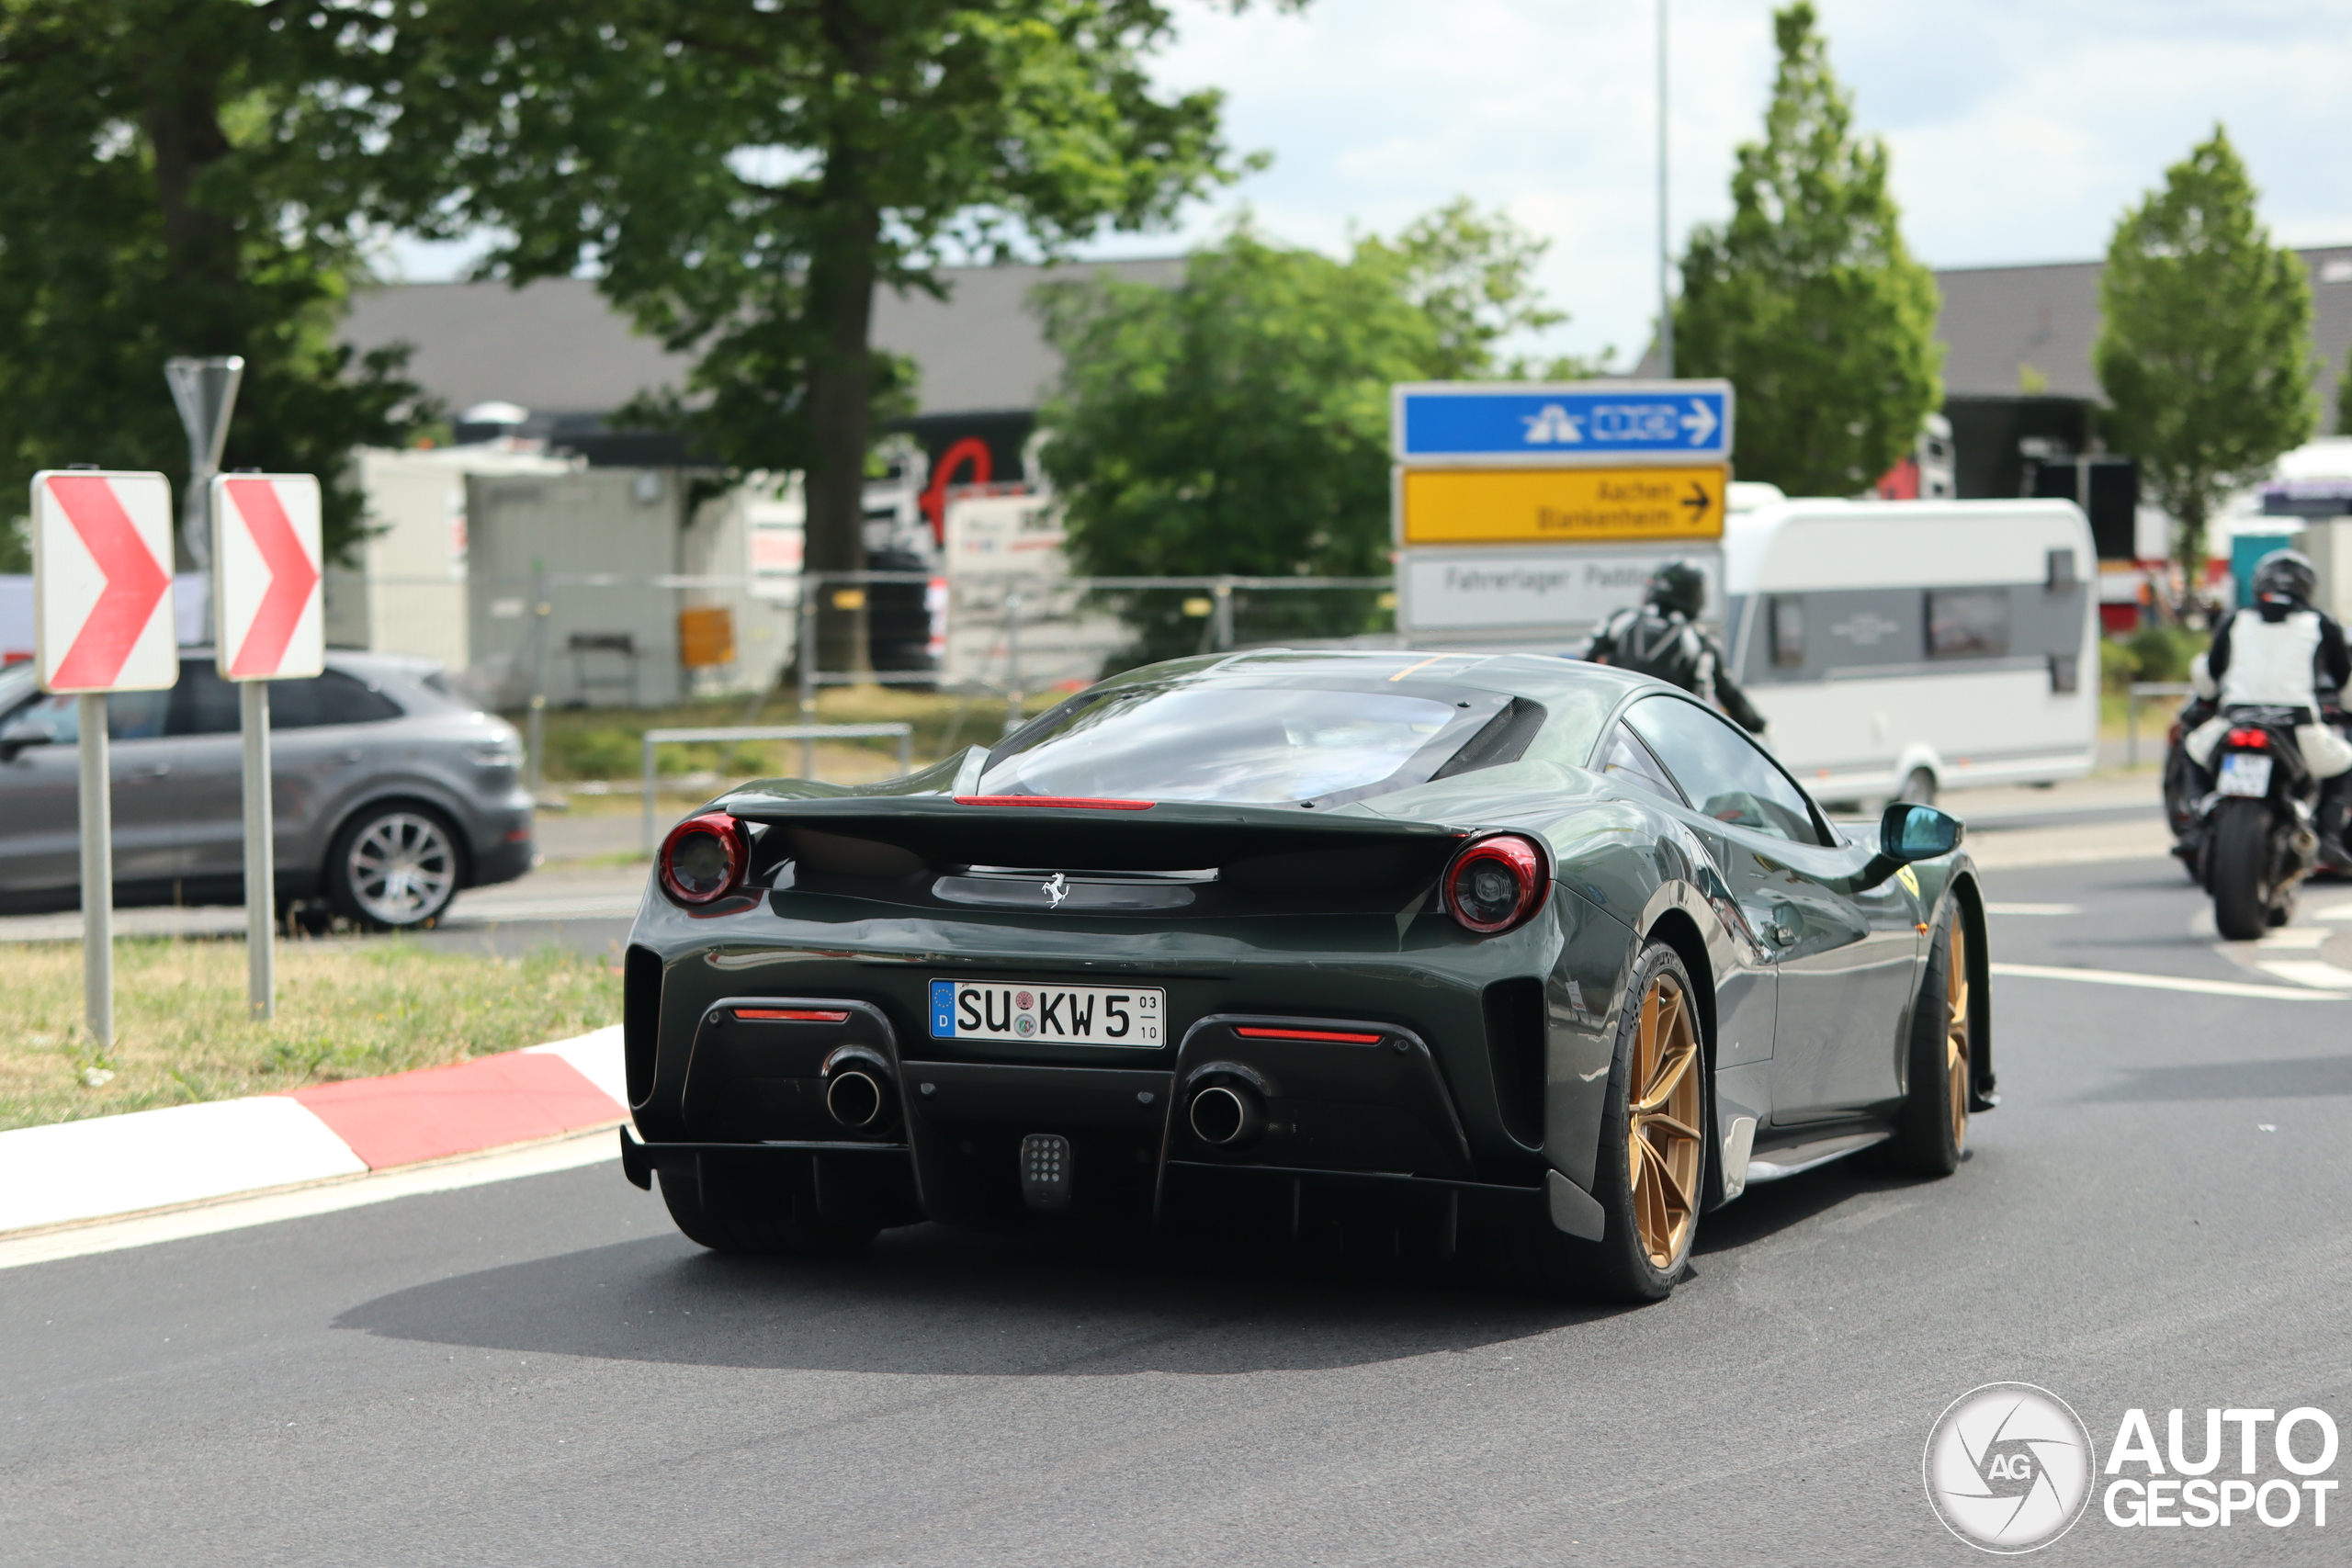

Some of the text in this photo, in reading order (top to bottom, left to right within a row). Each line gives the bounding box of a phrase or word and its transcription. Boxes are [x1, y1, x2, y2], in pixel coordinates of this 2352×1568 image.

[1139, 996, 1157, 1009] 03
[957, 989, 1011, 1032] SU
[1040, 992, 1094, 1036] KW
[1105, 995, 1130, 1037] 5
[939, 1014, 948, 1027] D
[1141, 1026, 1157, 1039] 10
